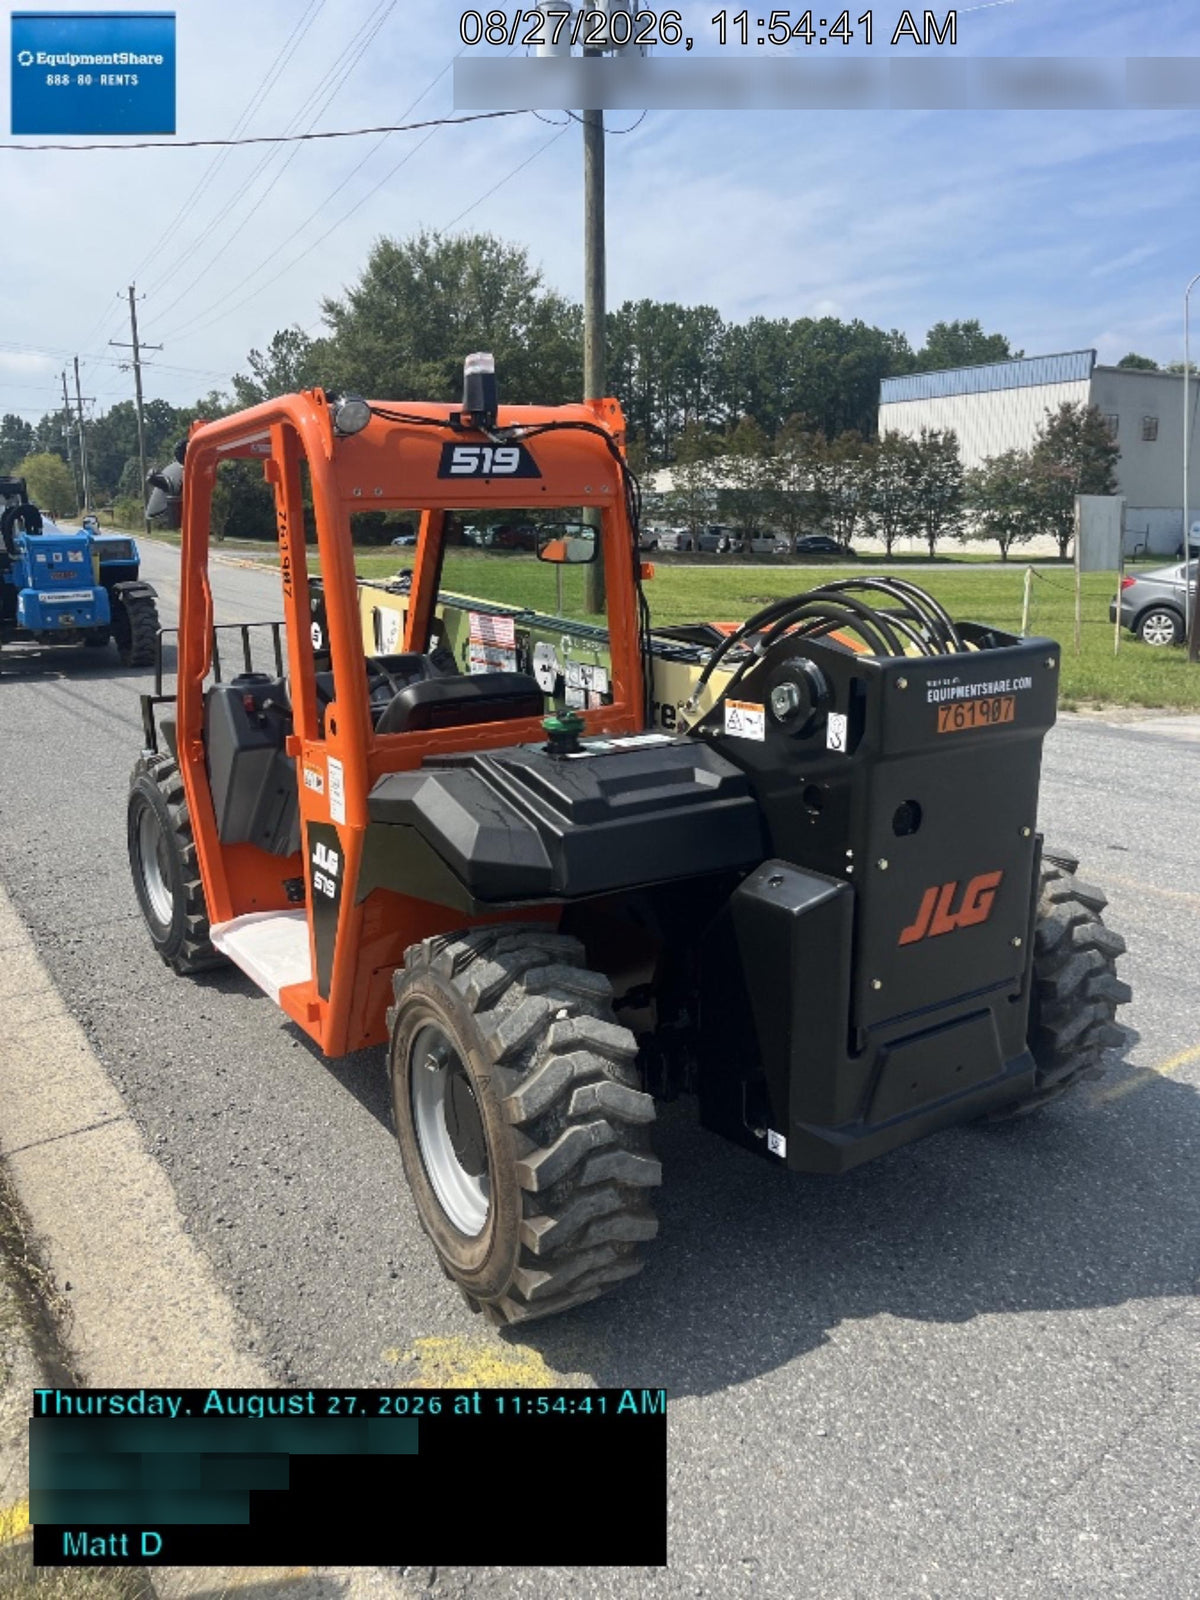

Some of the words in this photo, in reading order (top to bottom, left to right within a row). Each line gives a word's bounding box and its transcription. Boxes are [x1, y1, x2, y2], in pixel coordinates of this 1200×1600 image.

[450, 447, 520, 474] 519
[927, 676, 1033, 703] EQUIPMENTSHARE.COM
[940, 696, 1014, 732] 761907
[312, 842, 339, 876] JLG
[313, 870, 336, 899] 519
[898, 869, 1003, 946] JLG
